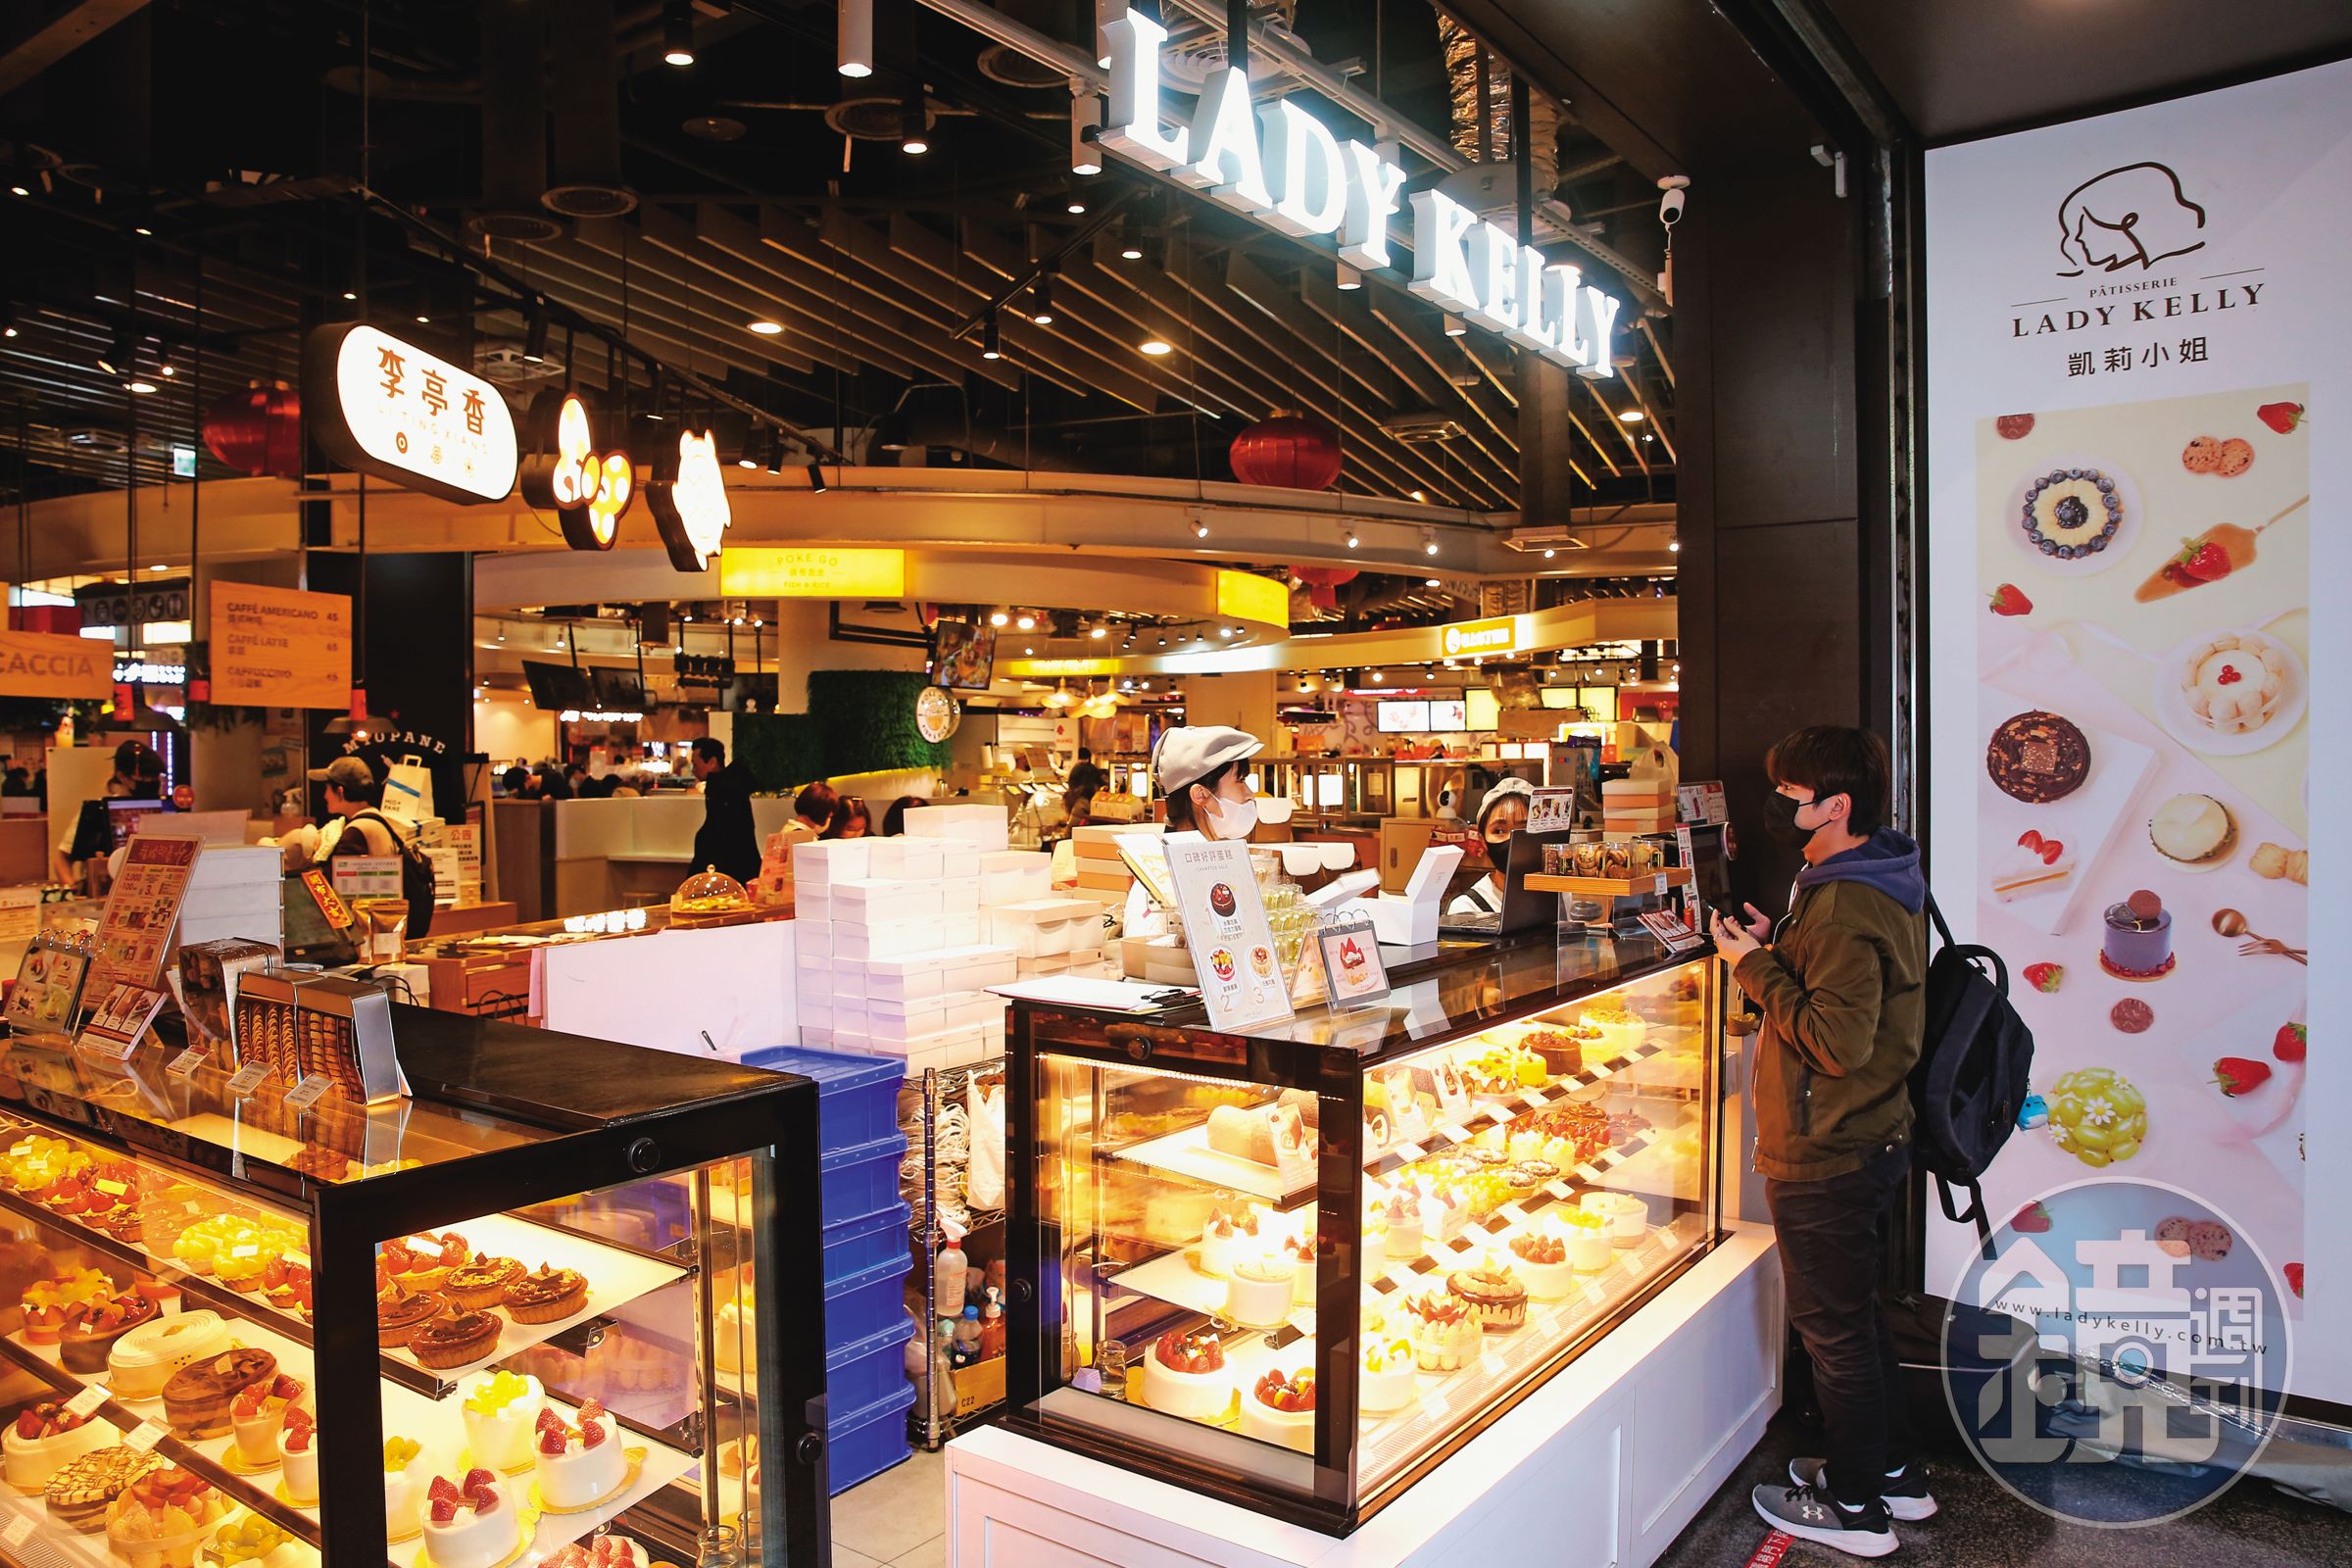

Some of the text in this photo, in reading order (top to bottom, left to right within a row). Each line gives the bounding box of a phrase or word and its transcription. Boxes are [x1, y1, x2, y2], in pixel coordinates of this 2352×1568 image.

[1120, 7, 1621, 379] LADY KELLY
[2012, 282, 2267, 338] LADY KELLY
[2088, 276, 2179, 299] PÂTISSERIE
[2067, 335, 2210, 377] 凱莉小姐
[376, 346, 486, 436] 李亭香
[1993, 1298, 2268, 1355] www.ladykelly.com.tw
[961, 1396, 975, 1407] C22
